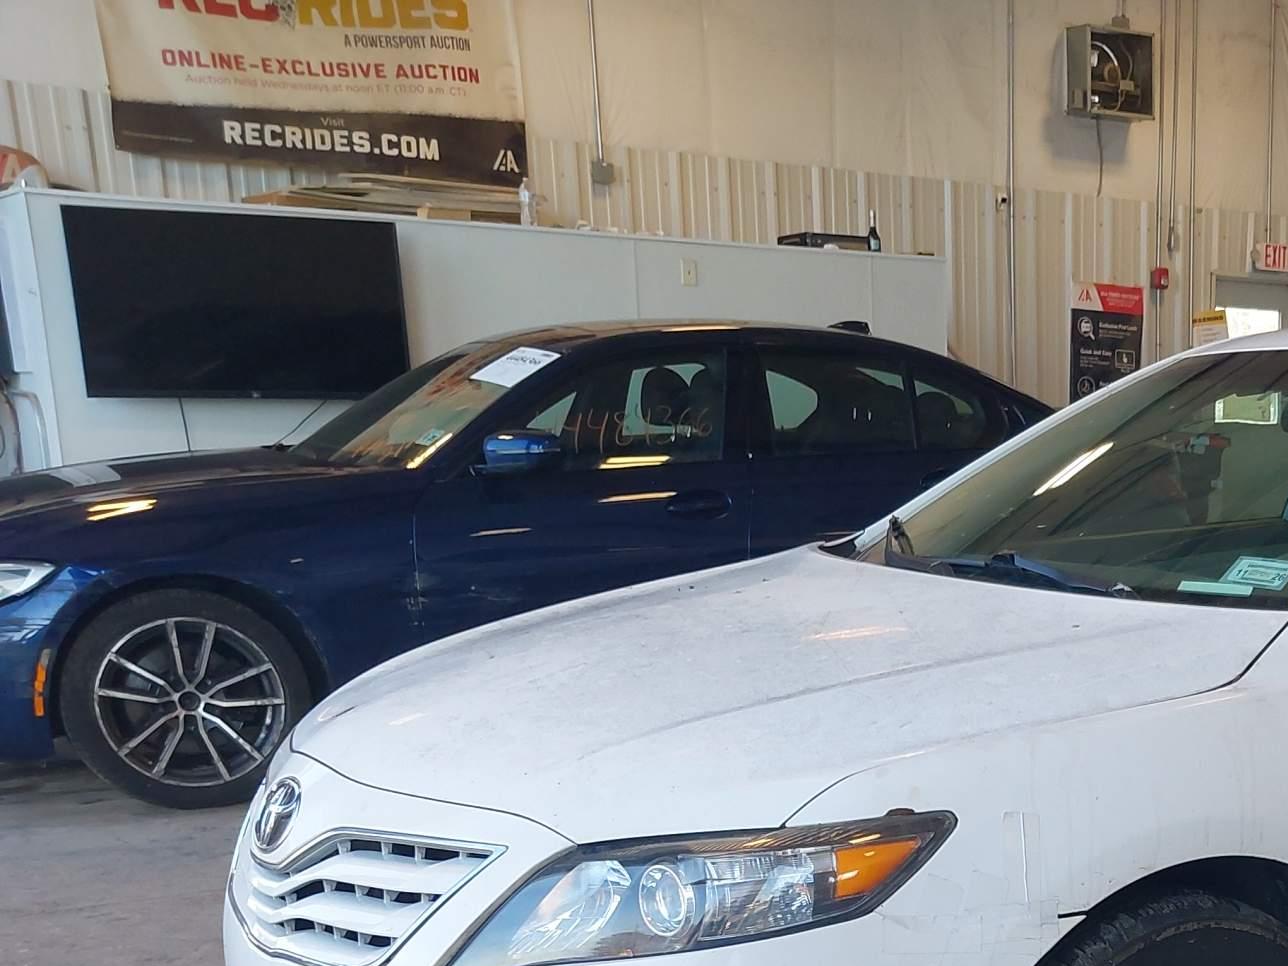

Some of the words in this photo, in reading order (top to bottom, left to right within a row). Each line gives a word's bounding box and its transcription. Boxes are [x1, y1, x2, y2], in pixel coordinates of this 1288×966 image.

[344, 34, 352, 48] A
[354, 34, 426, 49] POWERSPORT
[430, 35, 471, 51] AUCTION
[161, 49, 387, 79] ONLINE-EXCLUSIVE
[395, 63, 480, 84] AUCTION
[320, 117, 344, 128] Visit
[223, 119, 440, 161] RECRIDES.COM
[1264, 244, 1287, 269] EXIT
